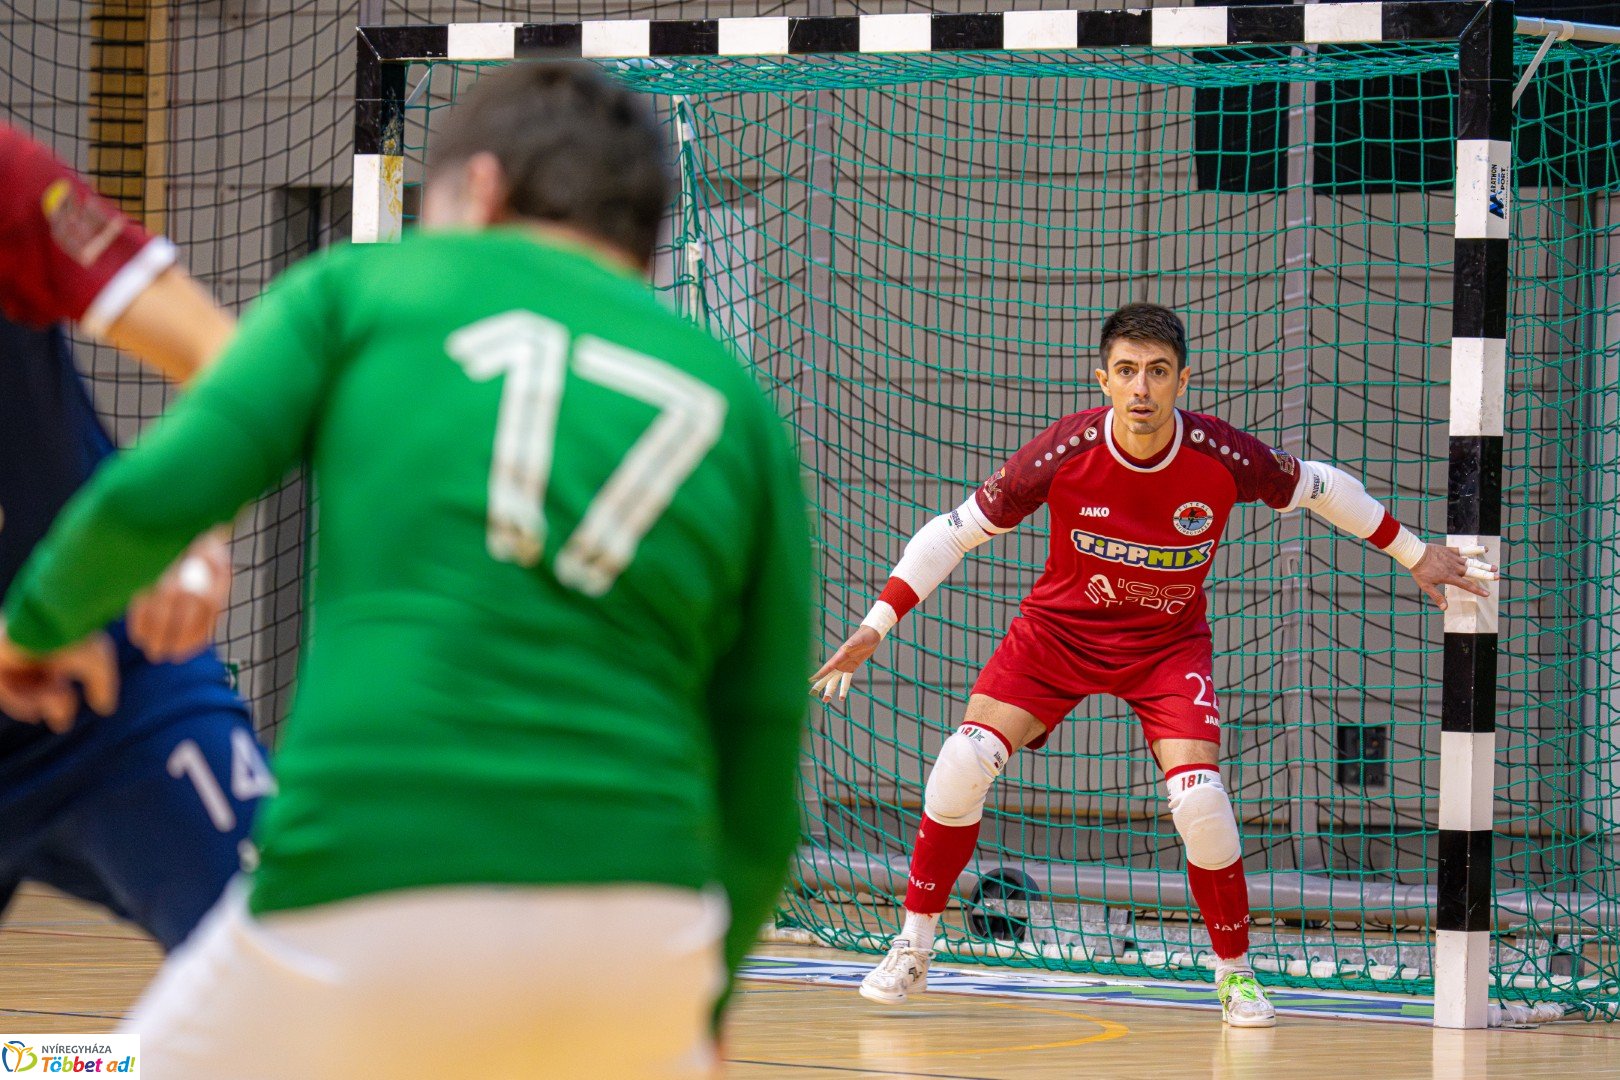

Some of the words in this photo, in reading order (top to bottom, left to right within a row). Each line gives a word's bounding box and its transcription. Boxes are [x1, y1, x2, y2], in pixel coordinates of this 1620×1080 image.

[444, 308, 729, 596] 17
[1079, 507, 1110, 517] JAKO
[1204, 714, 1220, 728] JAK
[166, 728, 279, 832] 14
[1181, 773, 1203, 791] 181
